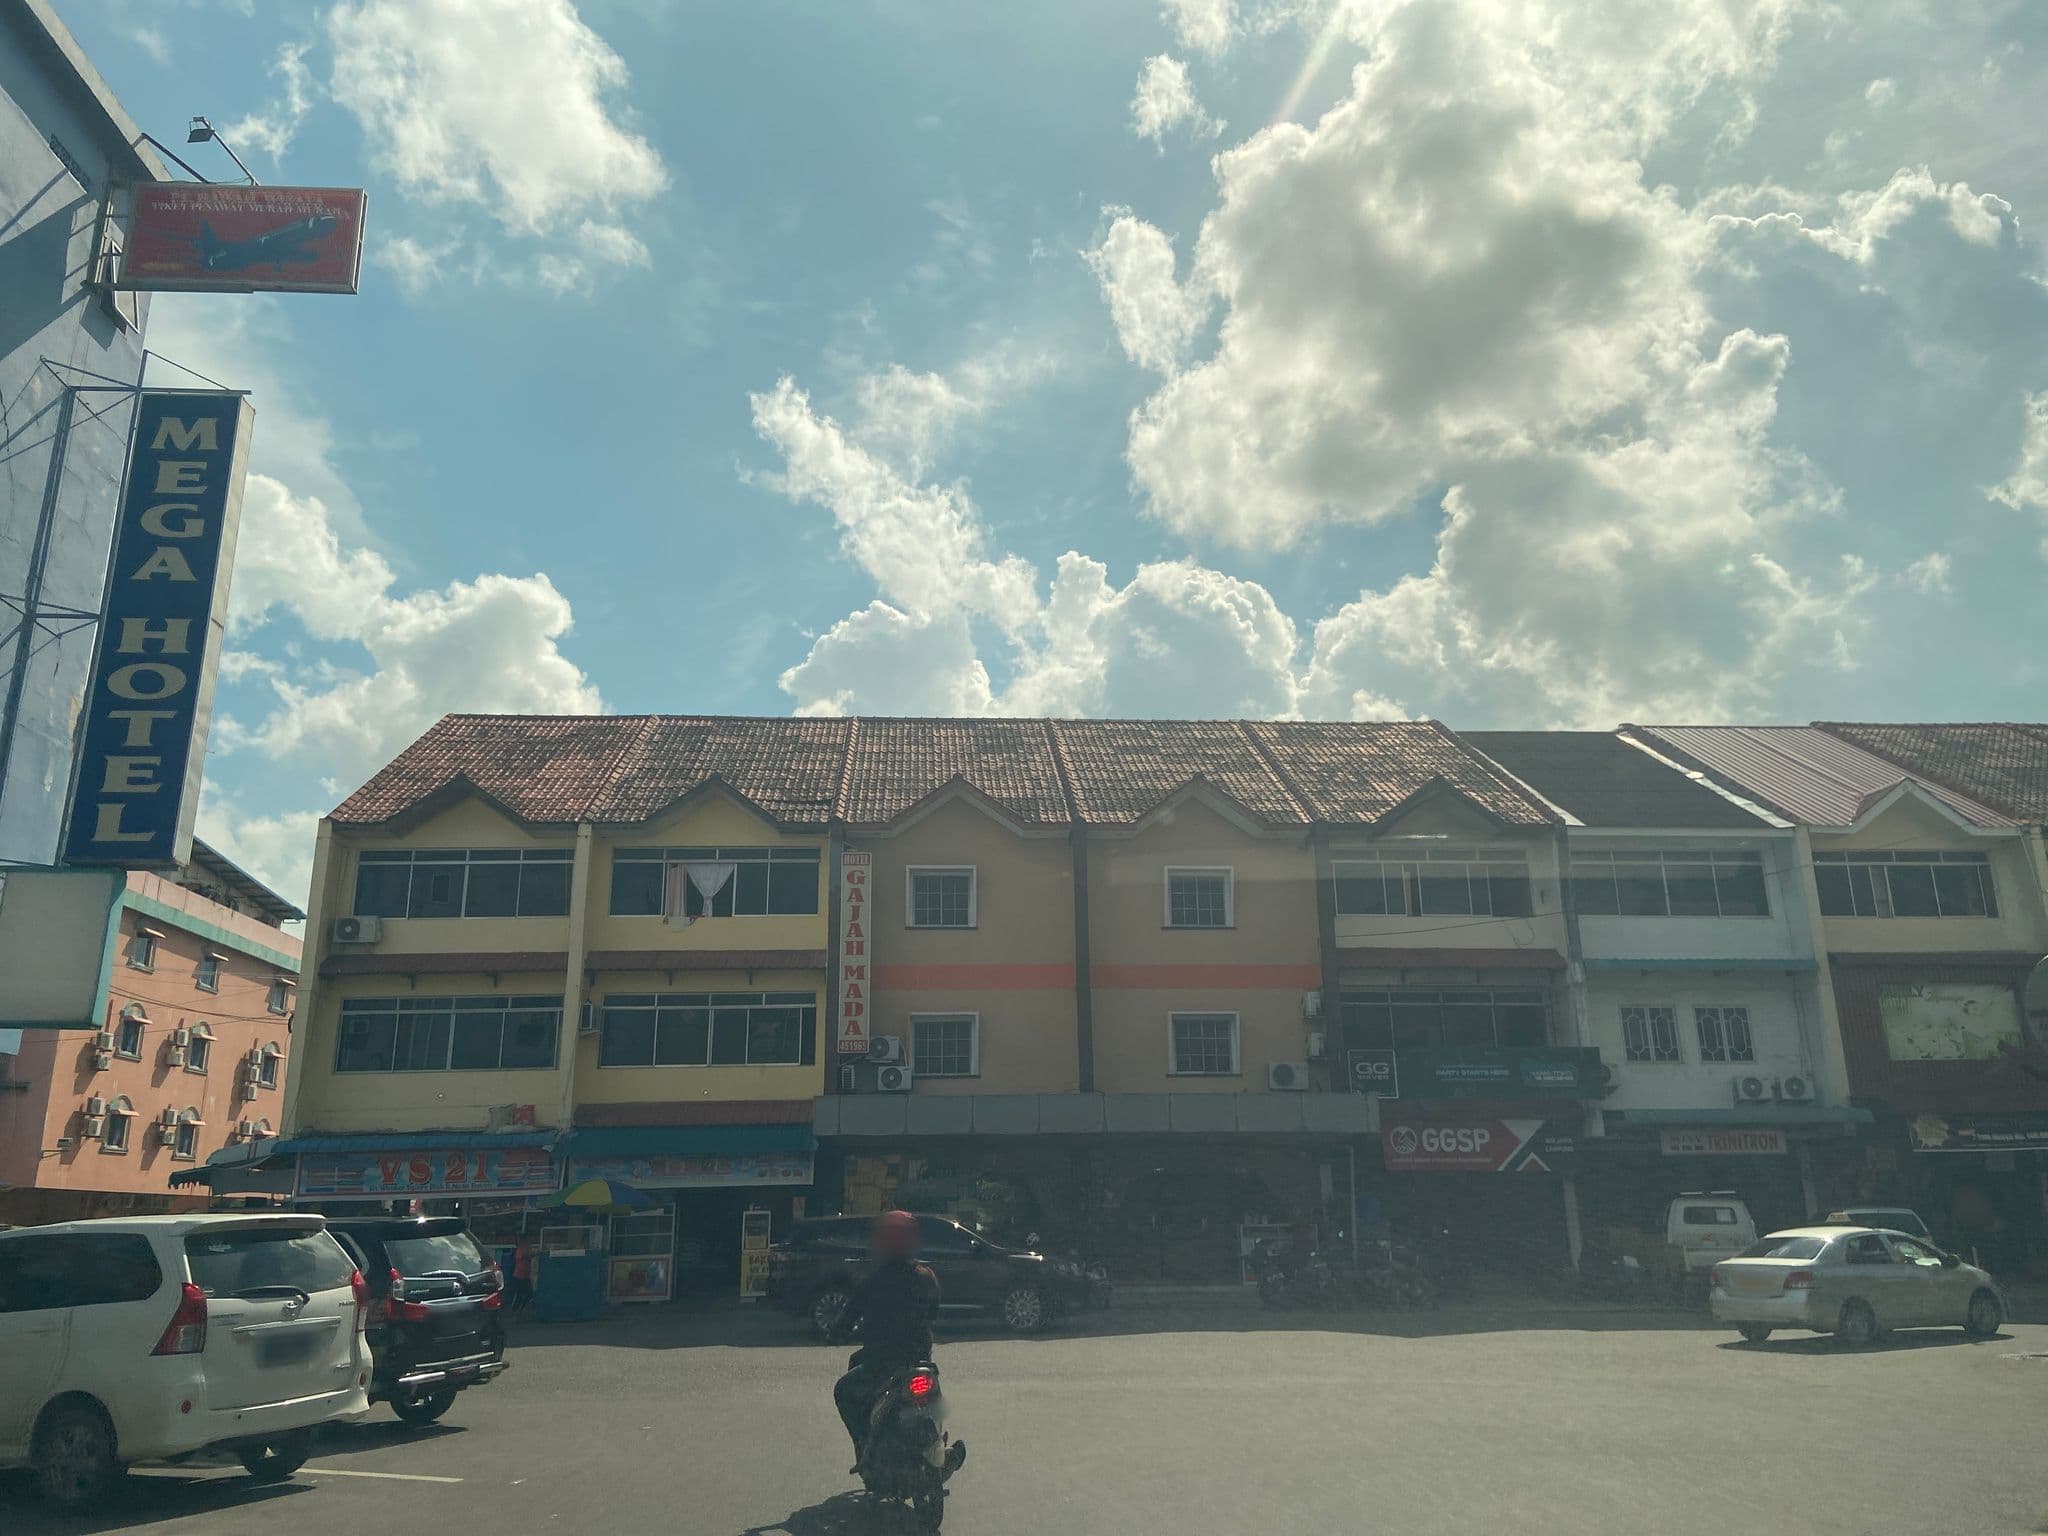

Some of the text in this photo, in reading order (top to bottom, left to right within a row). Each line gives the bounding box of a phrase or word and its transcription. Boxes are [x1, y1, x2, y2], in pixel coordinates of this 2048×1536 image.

[90, 416, 219, 843] MEGA HOTEL
[844, 854, 870, 865] HOTEL
[844, 869, 867, 1036] GAJAH MADA
[1355, 1062, 1390, 1075] GG
[1421, 1127, 1491, 1153] GGSP
